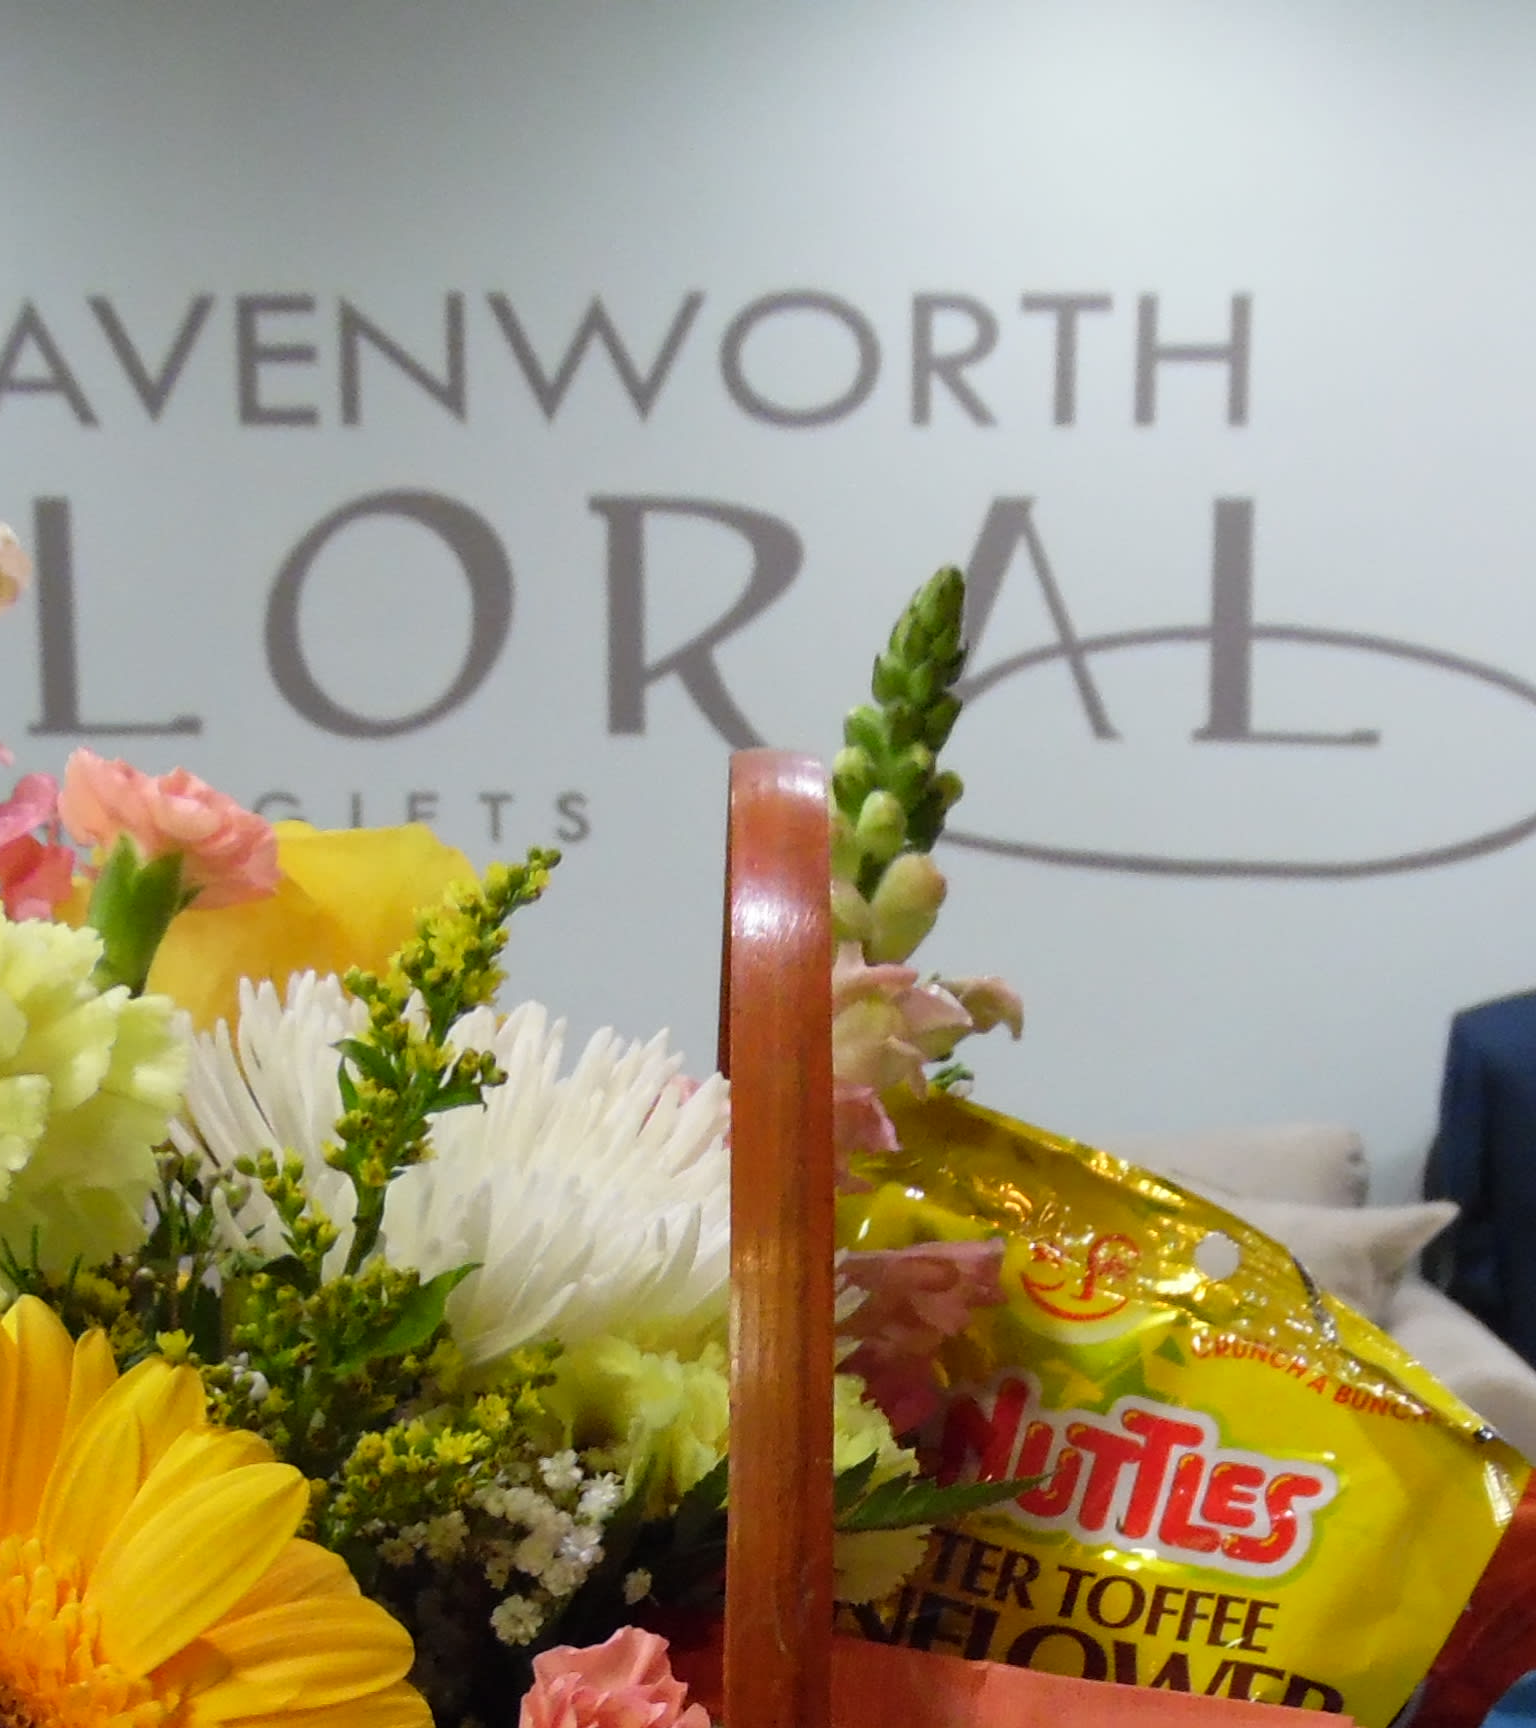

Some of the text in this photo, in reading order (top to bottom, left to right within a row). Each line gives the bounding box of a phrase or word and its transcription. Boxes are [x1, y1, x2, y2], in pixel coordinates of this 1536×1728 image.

[249, 790, 591, 843] GIFTS
[1307, 1375, 1330, 1395] A
[930, 1525, 1280, 1654] TER TOFFEE
